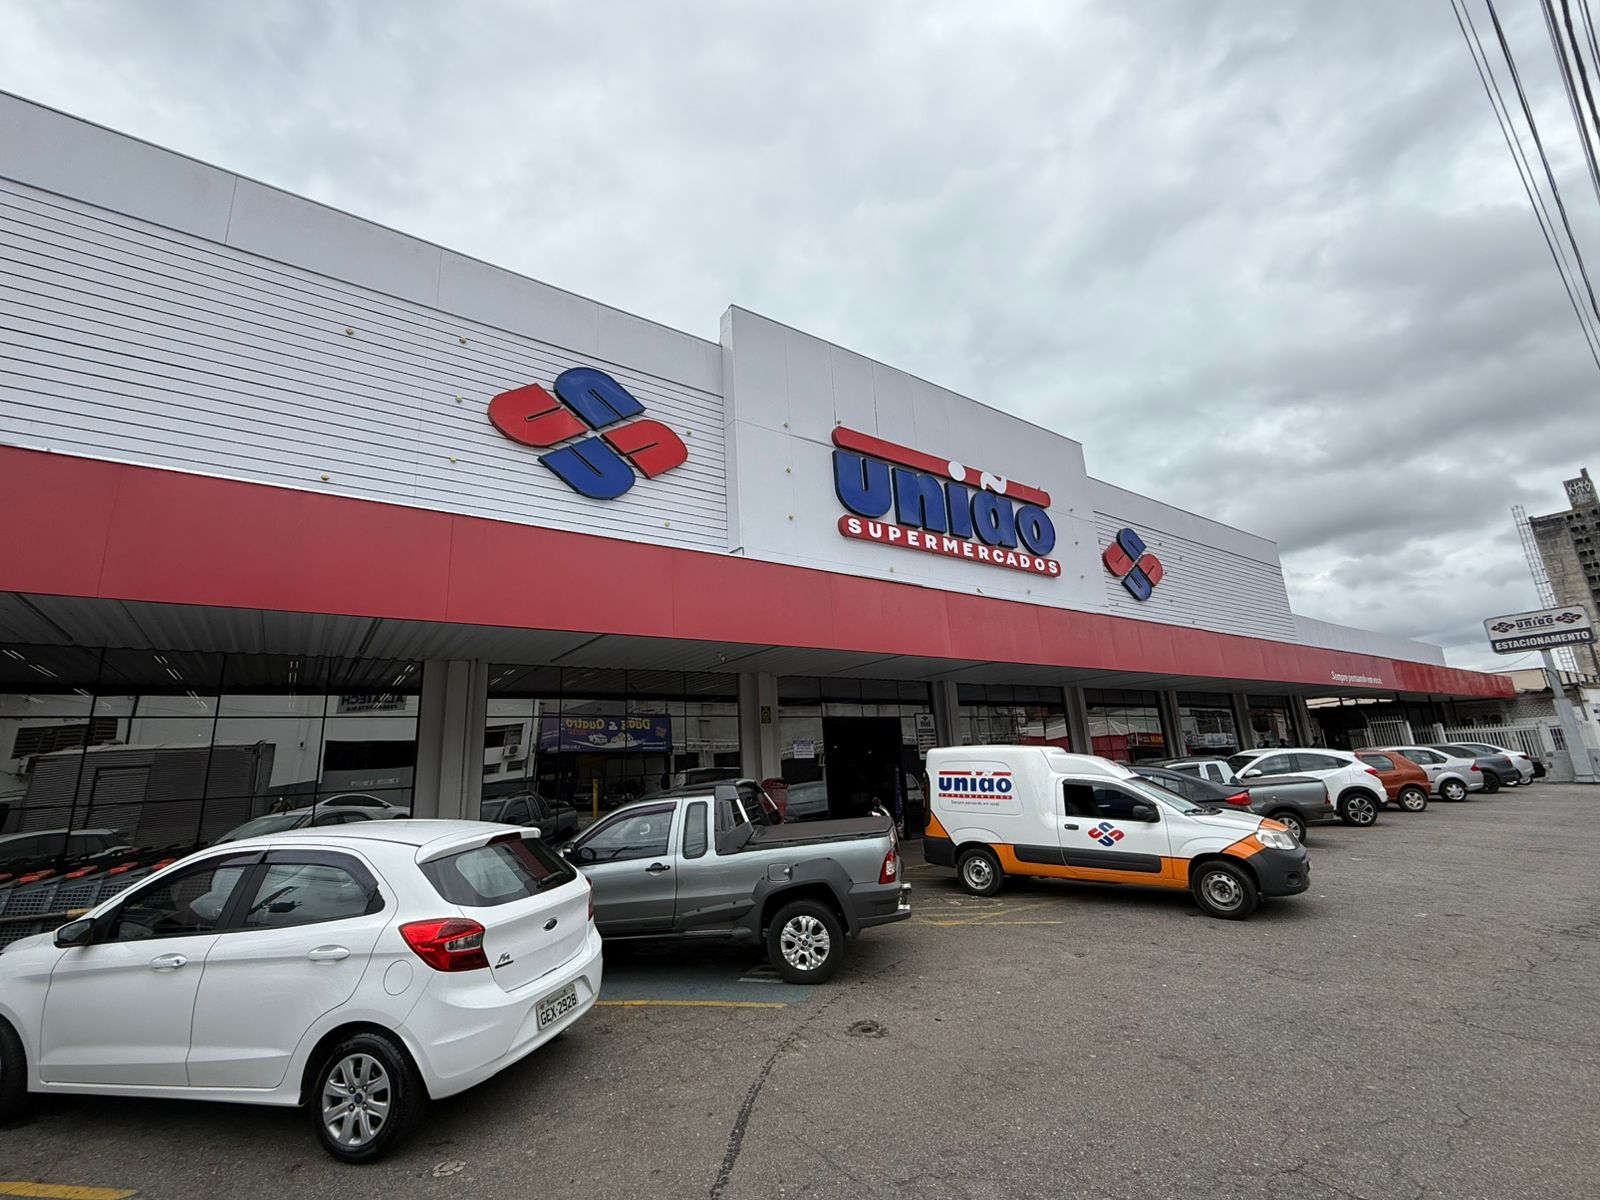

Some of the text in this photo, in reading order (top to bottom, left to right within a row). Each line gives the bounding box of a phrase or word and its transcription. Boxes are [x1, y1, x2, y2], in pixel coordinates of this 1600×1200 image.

[832, 450, 1056, 556] união
[847, 517, 1058, 574] SUPERMERCADOS
[1495, 630, 1590, 650] ESTACIONAMENTO
[938, 771, 1012, 793] união
